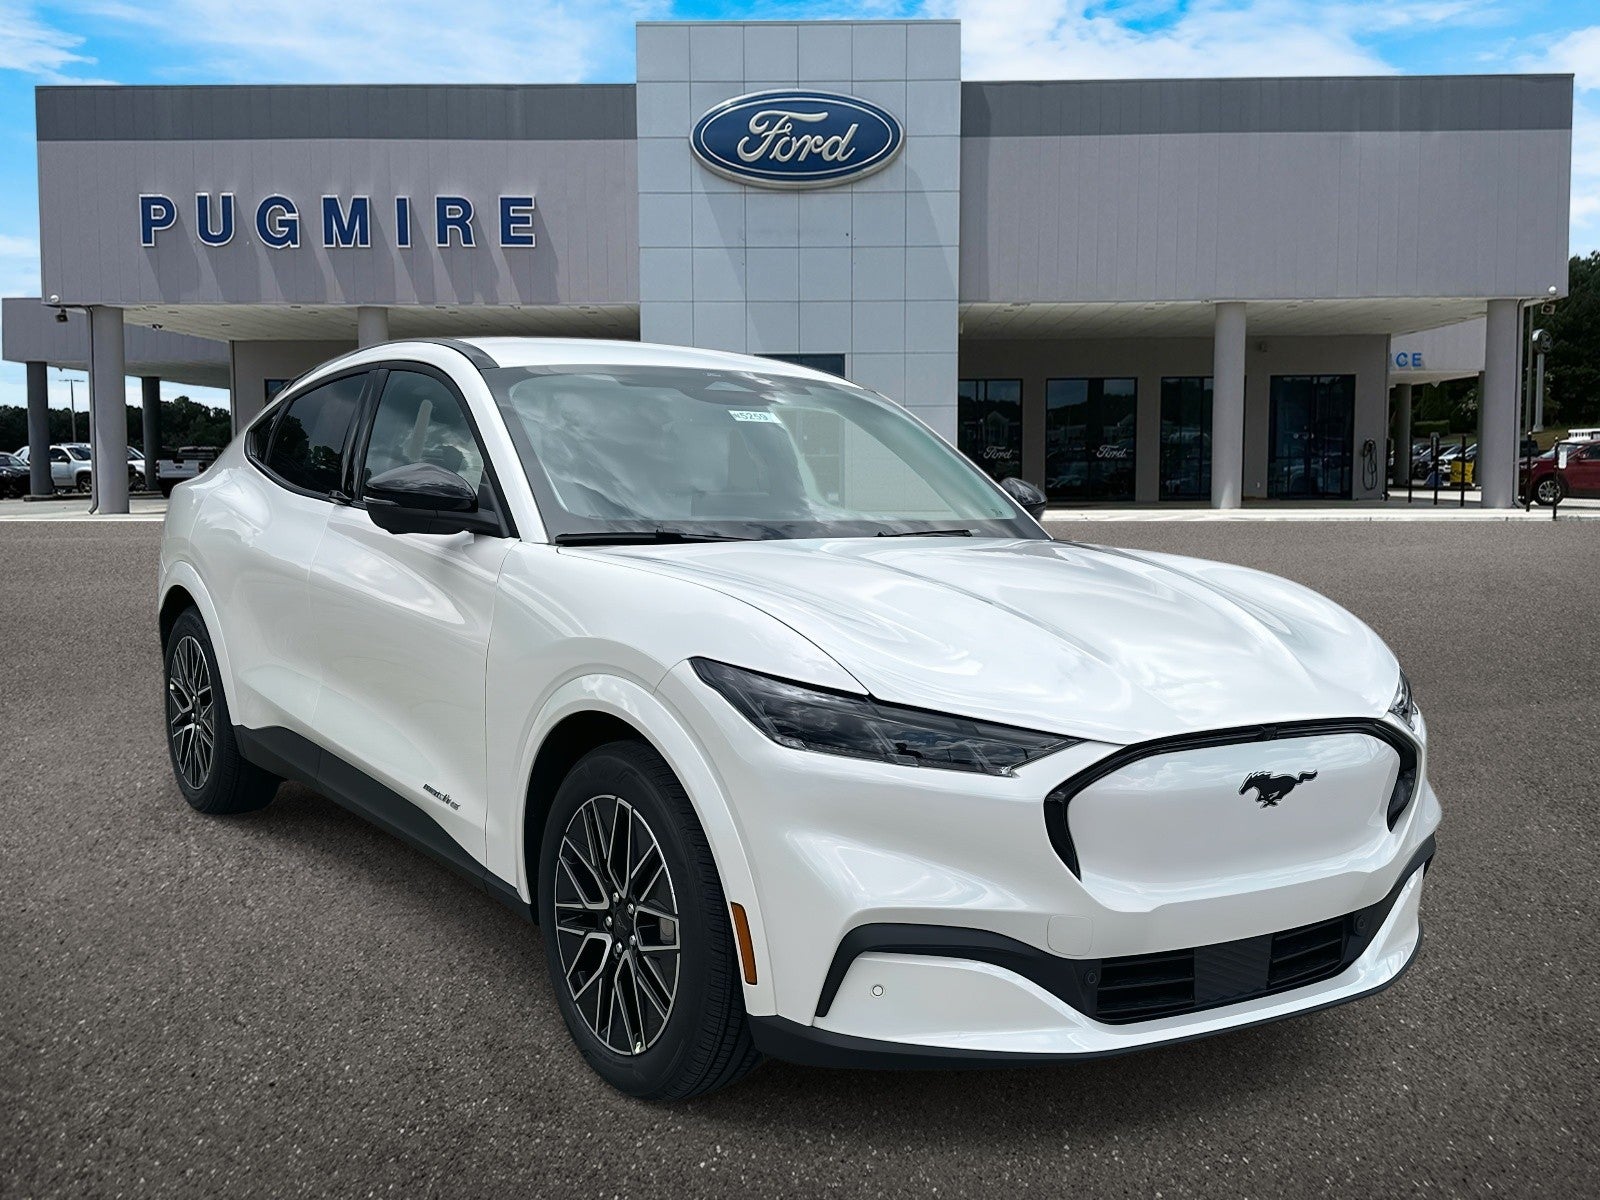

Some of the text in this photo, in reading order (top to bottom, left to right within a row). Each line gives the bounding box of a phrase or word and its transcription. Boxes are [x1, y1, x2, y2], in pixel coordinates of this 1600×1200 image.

[737, 110, 858, 162] Ford
[139, 193, 536, 249] PUGMIRE
[1390, 352, 1422, 368] CE
[983, 446, 1013, 459] Ford
[1096, 445, 1127, 458] Ford
